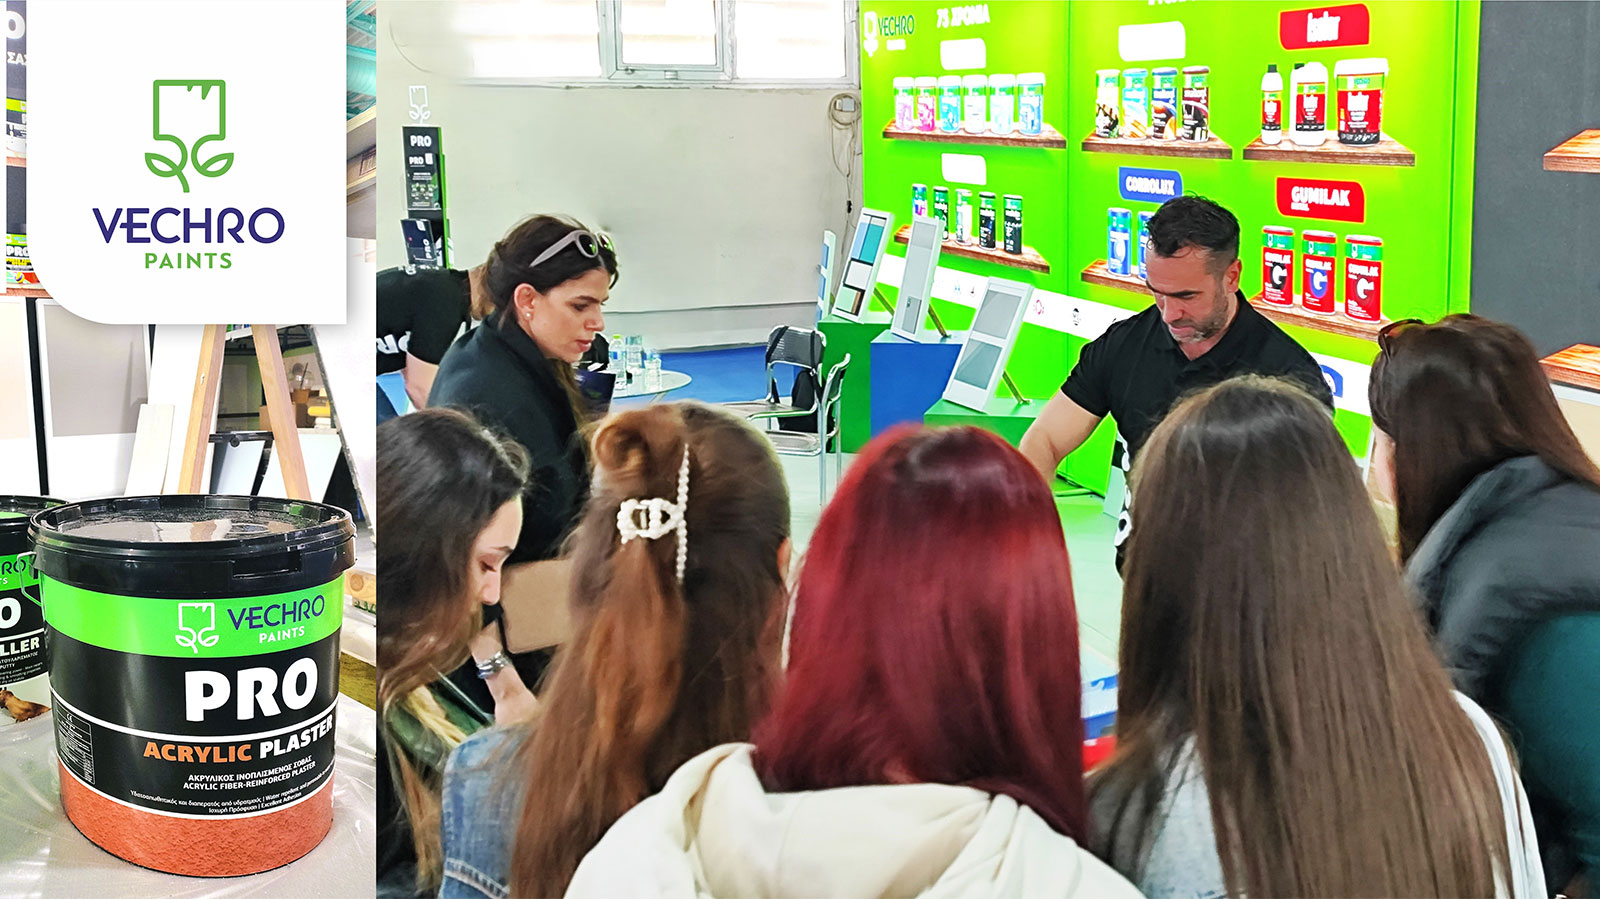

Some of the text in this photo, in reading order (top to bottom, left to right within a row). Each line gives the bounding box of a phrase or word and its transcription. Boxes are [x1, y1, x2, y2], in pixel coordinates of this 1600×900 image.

[878, 14, 915, 36] VECHRO
[410, 135, 432, 147] PRO
[1291, 186, 1350, 207] GUMILAK
[227, 595, 325, 631] VECHRO
[259, 626, 305, 644] PAINTS
[185, 657, 318, 722] PRO
[143, 713, 333, 763] ACRYLIC PLASTER
[183, 782, 218, 790] ACRYLIC
[220, 772, 291, 790] FIBER-REINFORCED
[291, 760, 316, 777] PLASTER
[187, 774, 234, 782] ΑΚΡΥΛΙΚΟΣ
[236, 763, 292, 780] ΙΝΟΠΛΙΣΜΕΝΟΣ
